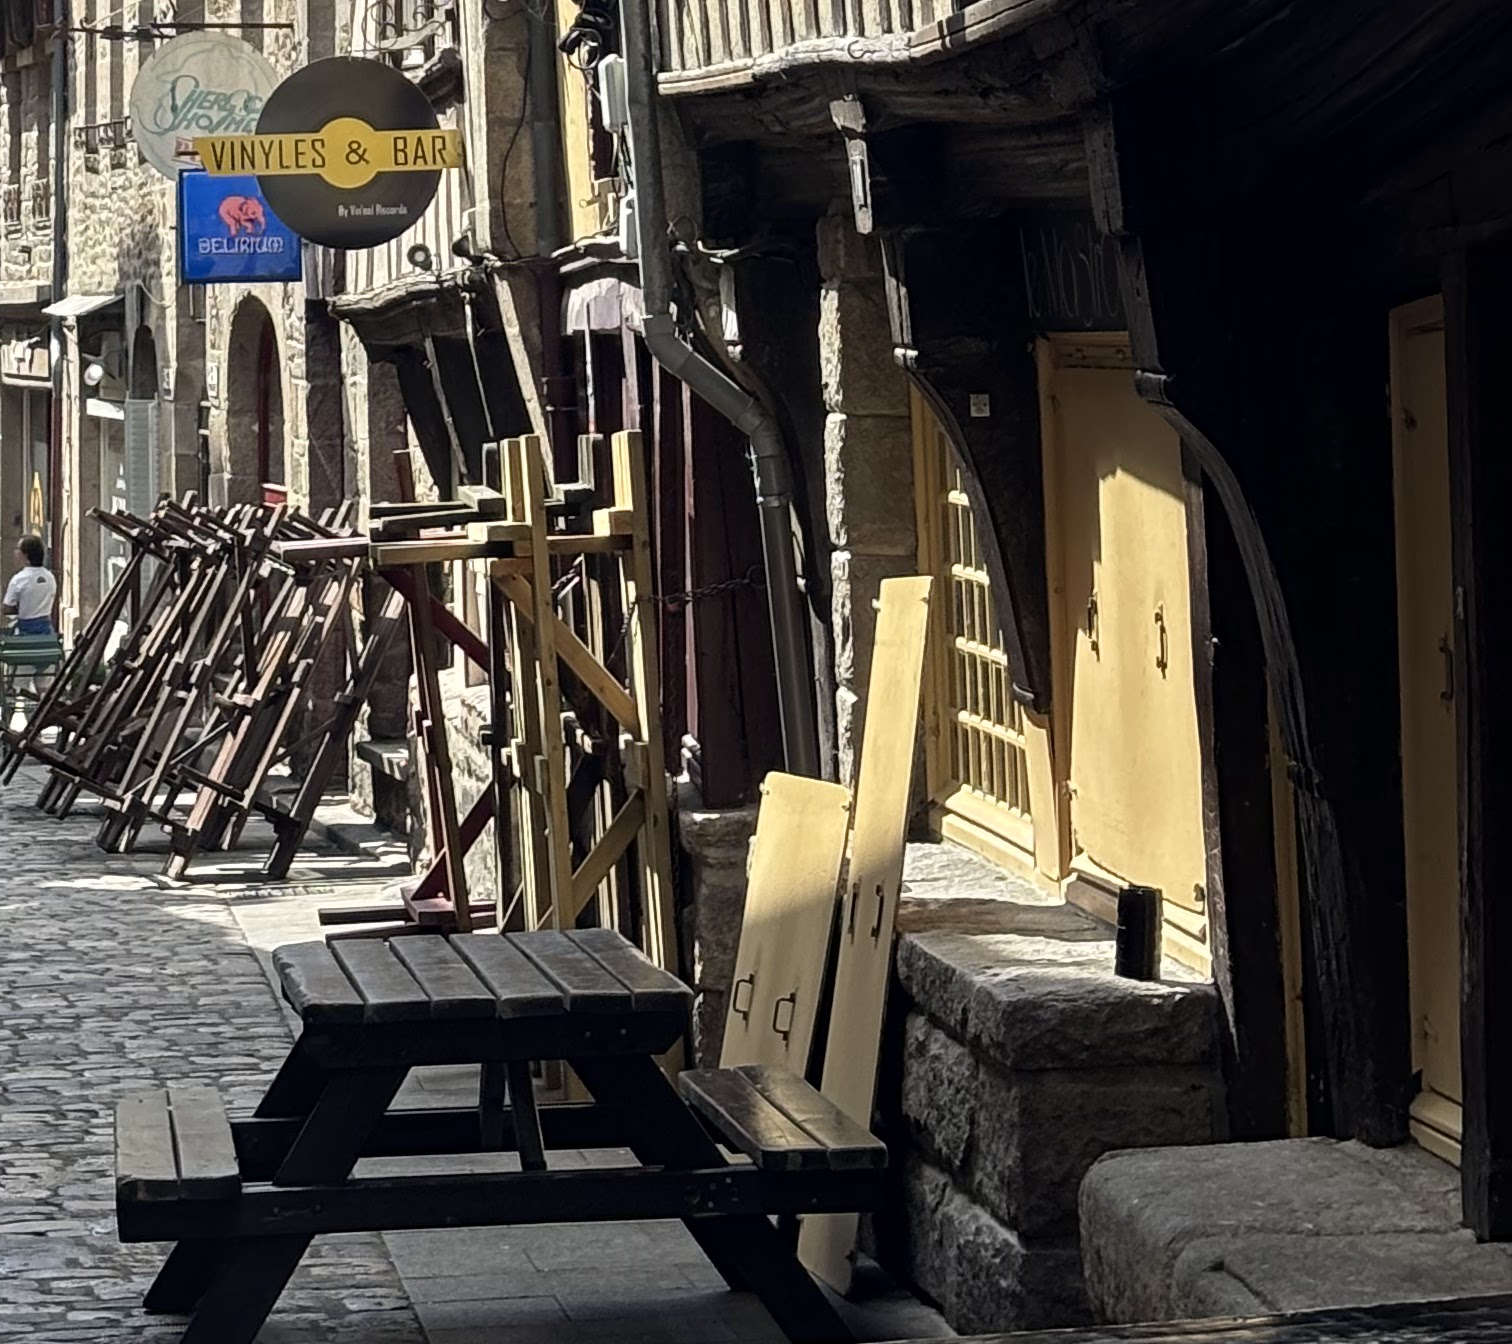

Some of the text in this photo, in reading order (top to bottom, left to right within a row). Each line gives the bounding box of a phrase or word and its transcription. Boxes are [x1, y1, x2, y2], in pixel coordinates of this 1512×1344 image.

[211, 137, 326, 172] VINYLES
[345, 140, 370, 165] &
[393, 135, 447, 166] BAR
[197, 235, 284, 254] DELIRIUM
